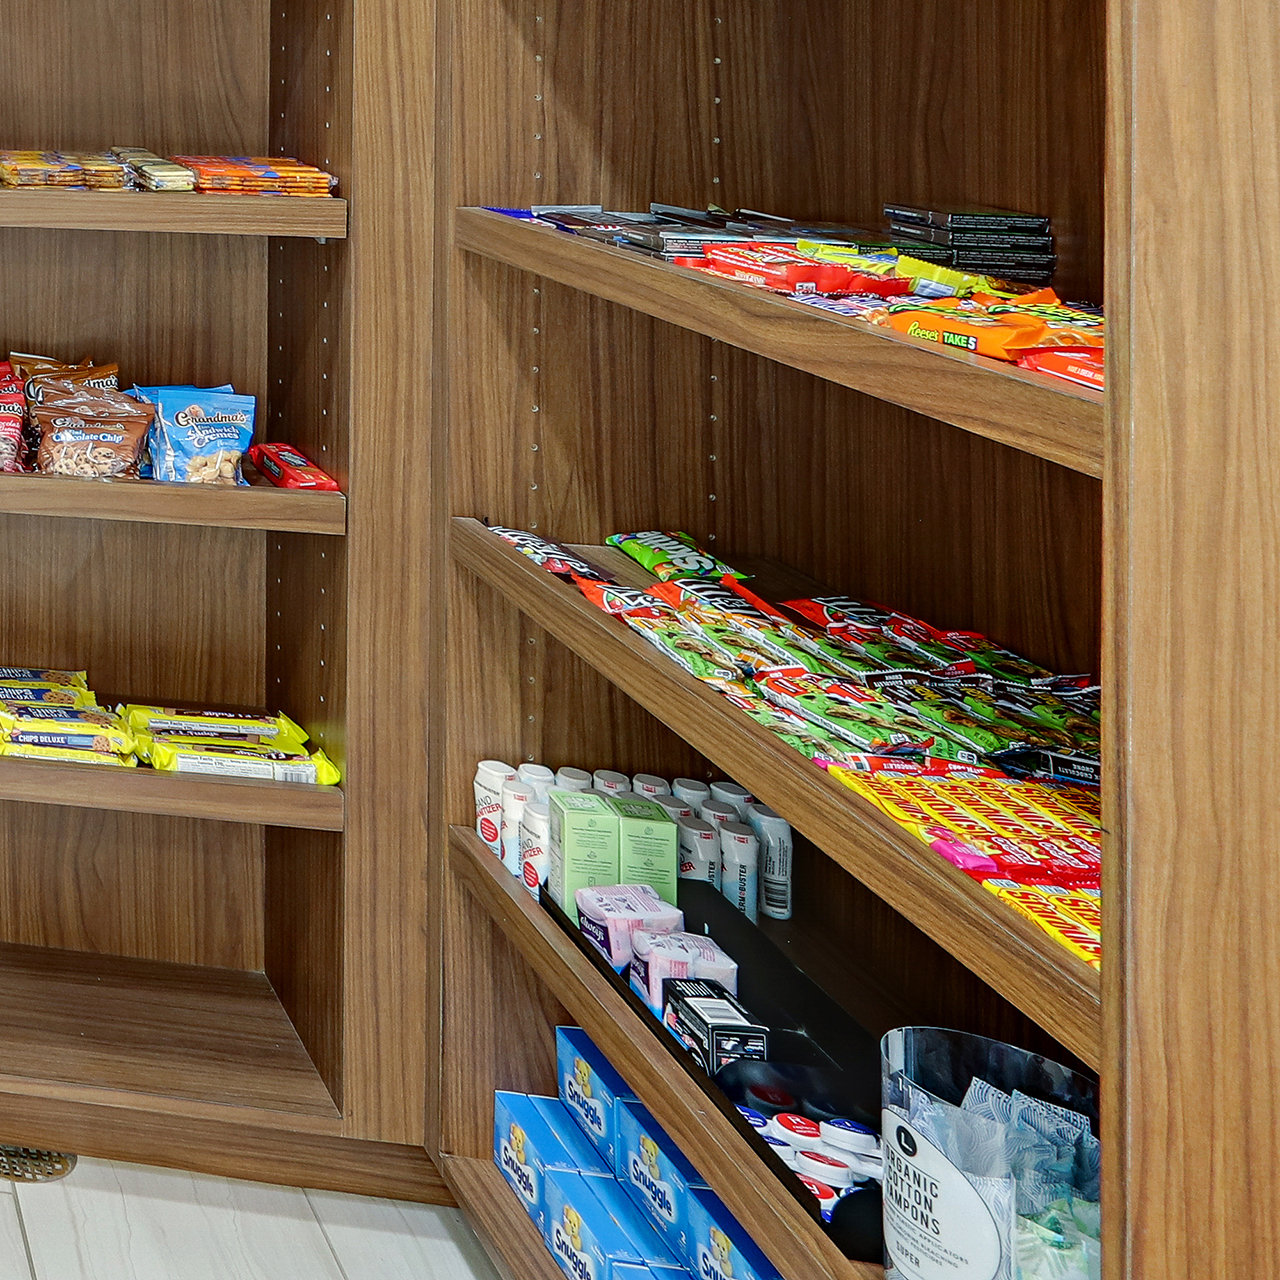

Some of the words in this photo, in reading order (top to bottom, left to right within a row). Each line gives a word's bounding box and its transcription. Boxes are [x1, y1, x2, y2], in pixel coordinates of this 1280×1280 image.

[907, 321, 938, 341] Reese's
[943, 332, 967, 347] TAKE
[968, 337, 977, 350] 5
[98, 433, 124, 443] Chip
[174, 411, 246, 427] Grandma's
[189, 425, 240, 440] Sandwich
[194, 431, 239, 447] Cremes
[568, 1081, 603, 1135] Snuggle
[900, 1132, 914, 1152] L
[503, 1145, 534, 1198] Snuggle
[632, 1162, 673, 1217] Snuggle
[886, 1144, 938, 1198] ORGANIC
[888, 1165, 932, 1213] COTTON
[886, 1178, 940, 1235] TAMPONS
